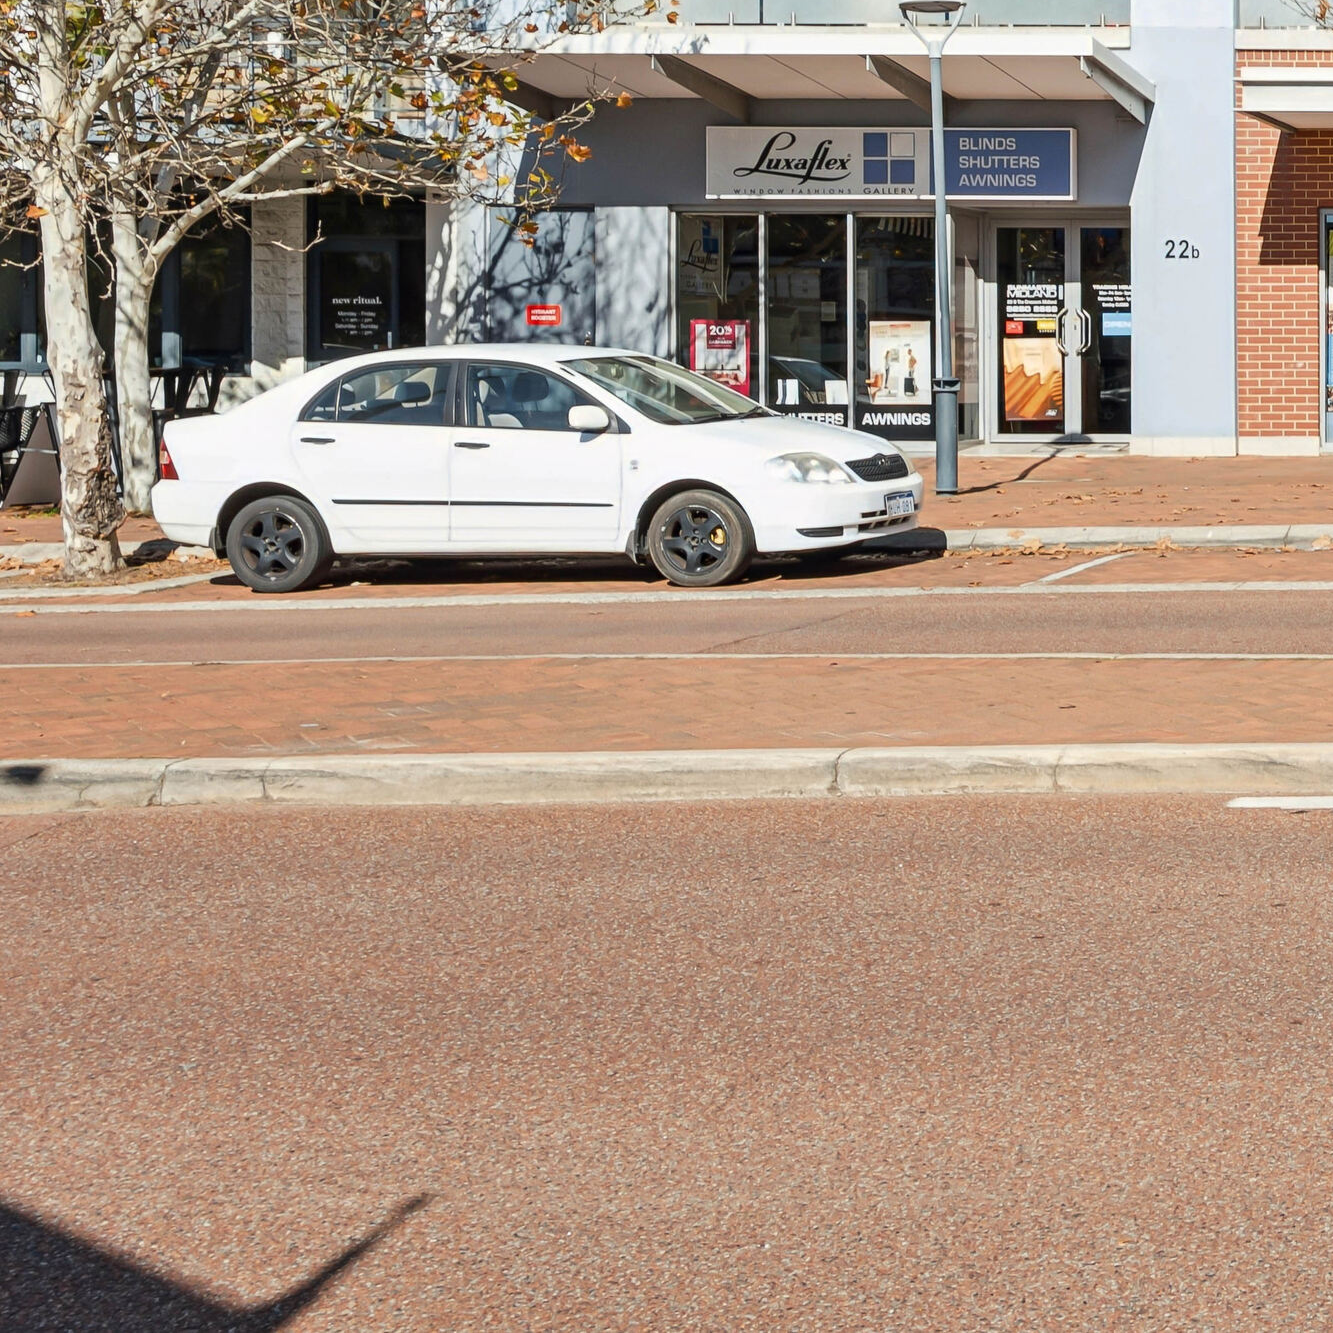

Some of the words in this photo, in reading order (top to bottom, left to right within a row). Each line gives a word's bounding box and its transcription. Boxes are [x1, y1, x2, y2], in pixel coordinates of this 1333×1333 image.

[959, 137, 1016, 150] BLINDS
[733, 131, 852, 186] Luxaflex
[959, 155, 1040, 168] SHUTTERS
[959, 173, 1037, 187] AWNINGS
[863, 187, 915, 195] GALLERY
[1165, 240, 1200, 258] 22b
[1006, 289, 1057, 298] MIDLAND
[782, 412, 845, 426] UTTERS
[862, 412, 931, 426] AWNINGS
